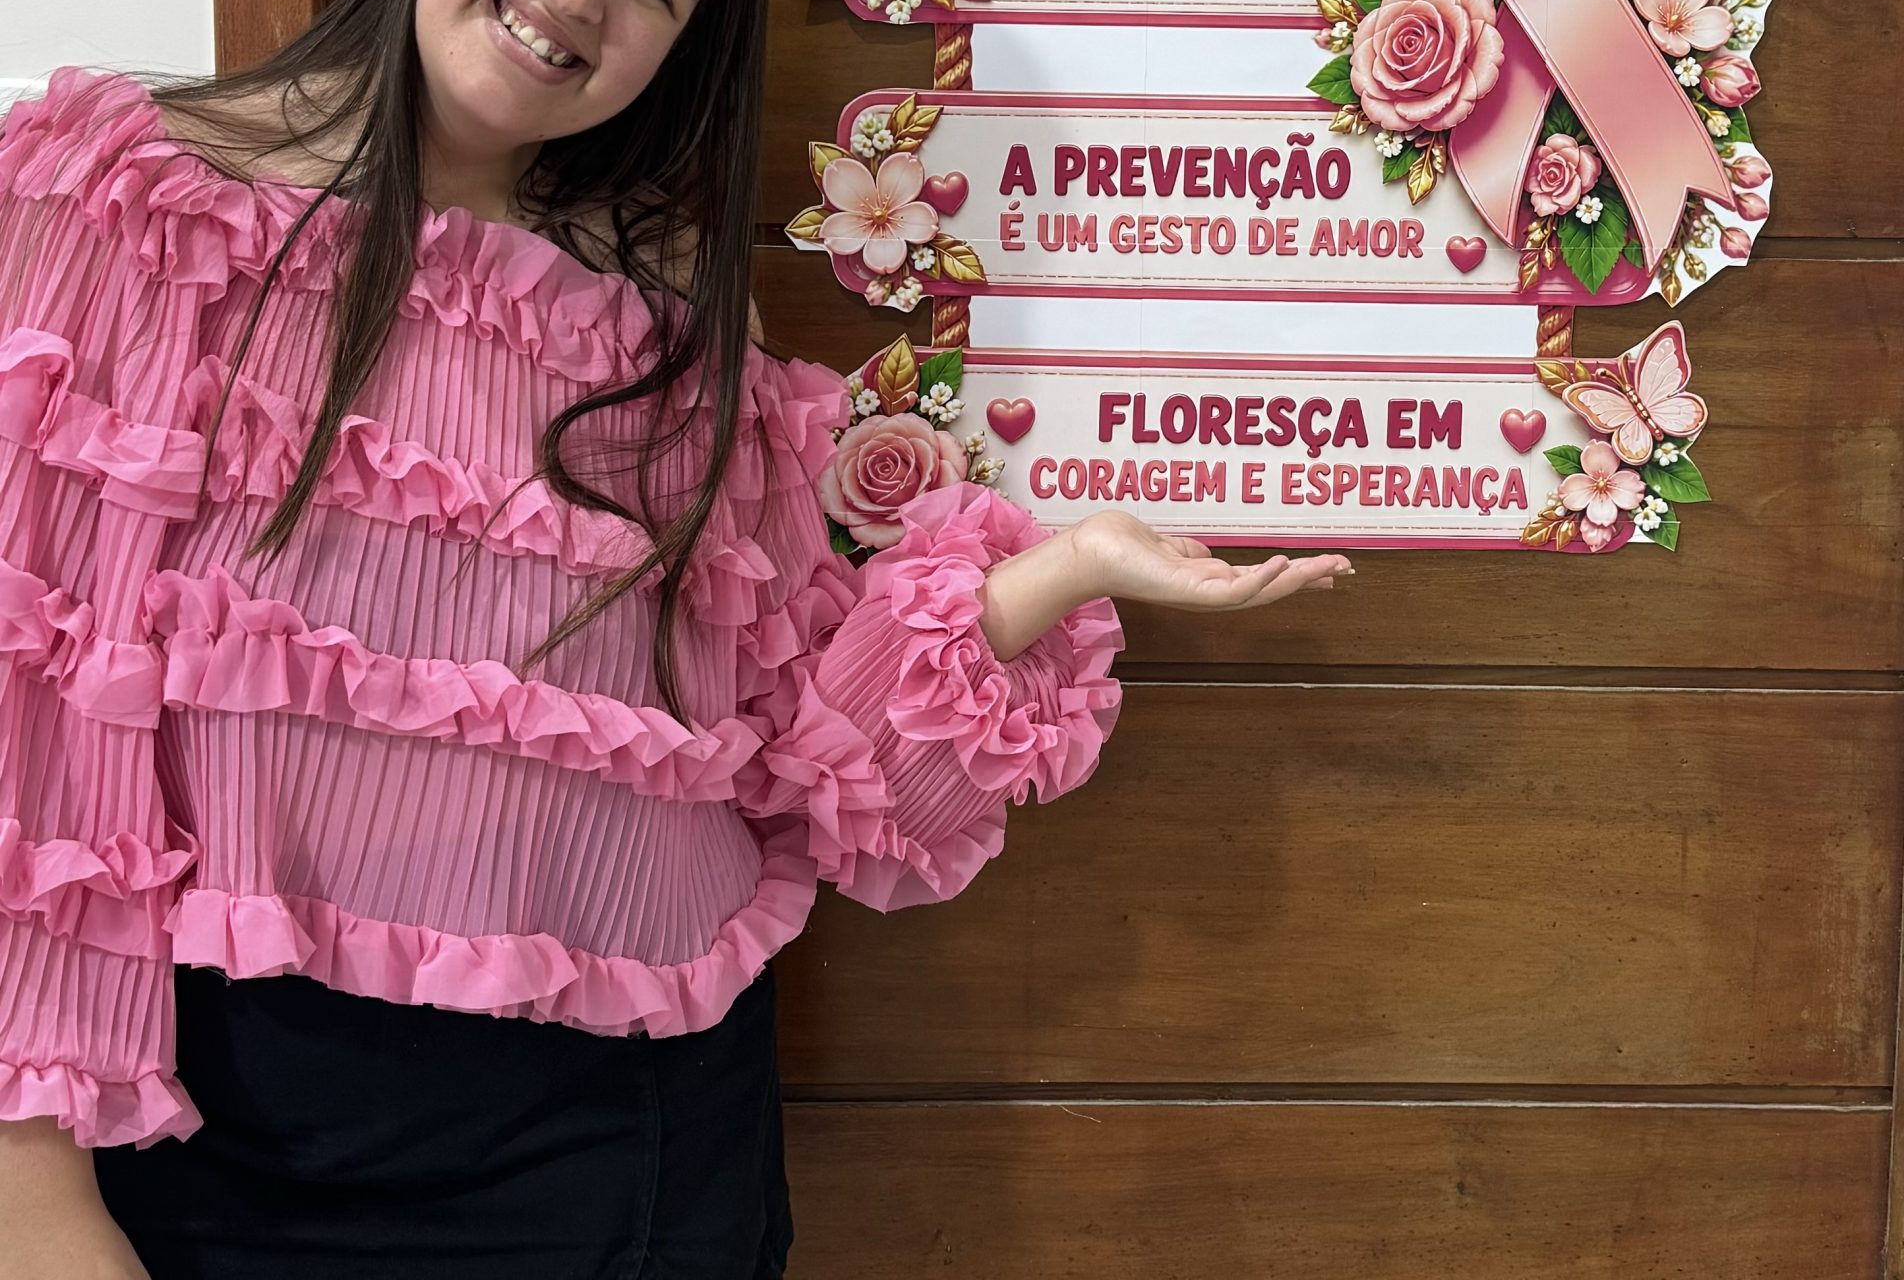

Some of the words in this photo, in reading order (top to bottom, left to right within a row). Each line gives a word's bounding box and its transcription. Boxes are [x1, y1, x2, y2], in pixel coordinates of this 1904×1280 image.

[999, 143, 1037, 197] A
[1053, 131, 1352, 210] PREVENÇÃO
[1000, 200, 1026, 252] É
[1037, 212, 1099, 252] UM
[1109, 214, 1237, 256] GESTO
[1249, 217, 1299, 256] DE
[1309, 217, 1425, 259] AMOR
[1098, 392, 1371, 458] FLORESÇA
[1386, 398, 1463, 450] EM
[1029, 455, 1226, 503] CORAGEM
[1241, 461, 1266, 504] E
[1280, 462, 1529, 516] ESPERANÇA
